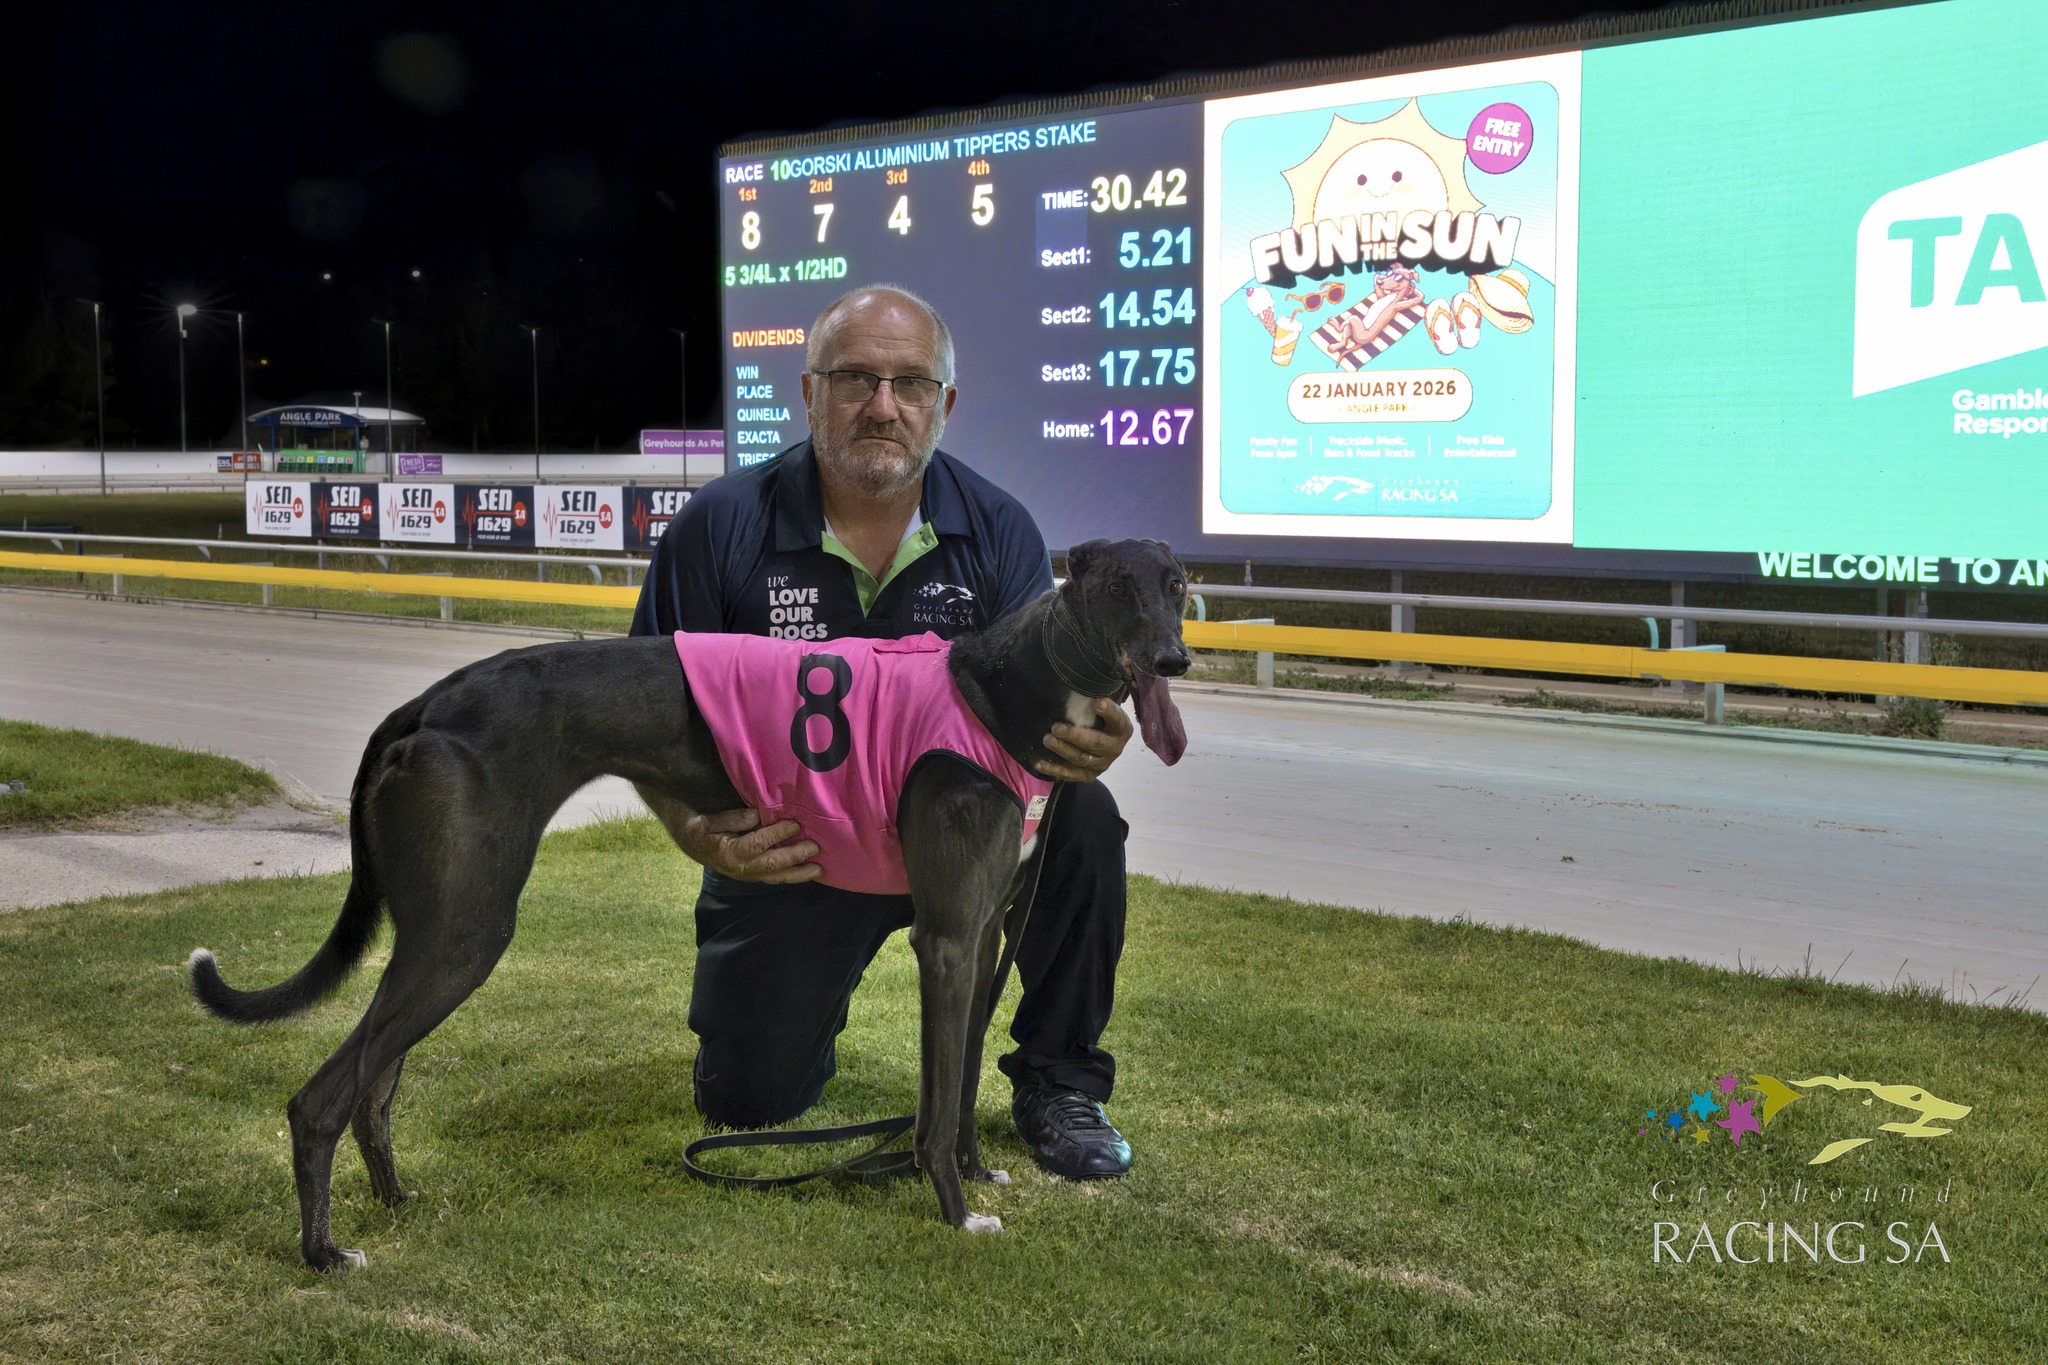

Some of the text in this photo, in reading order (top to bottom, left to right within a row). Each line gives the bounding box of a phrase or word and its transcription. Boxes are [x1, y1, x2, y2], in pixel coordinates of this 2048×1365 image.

[1484, 118, 1522, 138] FREE
[790, 121, 1096, 178] GORSKI ALUMINIUM TIPPERS STAKE
[1472, 135, 1524, 158] ENTRY
[726, 163, 790, 183] RACE 10
[738, 160, 990, 202] 1st 2nd 3rd 4th
[1042, 168, 1188, 213] TIME: 30.42
[742, 184, 994, 250] 8 7 4 5
[1361, 211, 1398, 242] IN
[1041, 227, 1192, 269] Sect1: 5.21
[1399, 210, 1521, 268] SUN
[1250, 215, 1359, 284] FUN
[1360, 242, 1398, 261] THE
[1888, 212, 2047, 308] TA
[725, 257, 847, 287] 5 3/4L x 1/2HD
[1041, 288, 1196, 328] Sect2: 14.54
[732, 328, 804, 348] DIVIDENDS
[736, 366, 758, 380] WIN
[1041, 348, 1196, 386] Sect3: 17.75
[736, 385, 773, 399] PLACE
[1302, 380, 1456, 399] 22 JANUARY 2026
[280, 412, 341, 420] ANGLE PARK
[737, 408, 790, 422] QUINELLA
[1346, 404, 1408, 413] ANGLE PARK
[1043, 408, 1194, 446] Home: 12.67
[644, 439, 724, 449] Greyhounds As Pet
[738, 431, 780, 444] EXACTA
[265, 486, 291, 504] SEN
[331, 486, 361, 506] SEN
[402, 488, 432, 508] SEN
[478, 489, 512, 510] SEN
[561, 491, 596, 512] SEN
[651, 491, 692, 515] SEN
[1382, 488, 1458, 502] RACING SA
[265, 511, 291, 523] 1629
[294, 503, 303, 513] SA
[362, 505, 372, 515] SA
[435, 508, 445, 517] SA
[514, 509, 526, 519] SA
[600, 511, 612, 522] SA
[330, 512, 359, 526] 1629
[401, 515, 431, 528] 1629
[477, 517, 511, 532] 1629
[560, 520, 595, 534] 1629
[1758, 551, 2048, 586] WELCOME TO AN
[768, 575, 789, 588] we
[769, 588, 819, 606] LOVE
[770, 606, 814, 624] OUR
[914, 612, 973, 626] RACING SA
[769, 623, 828, 641] DOGS
[790, 653, 852, 772] 8
